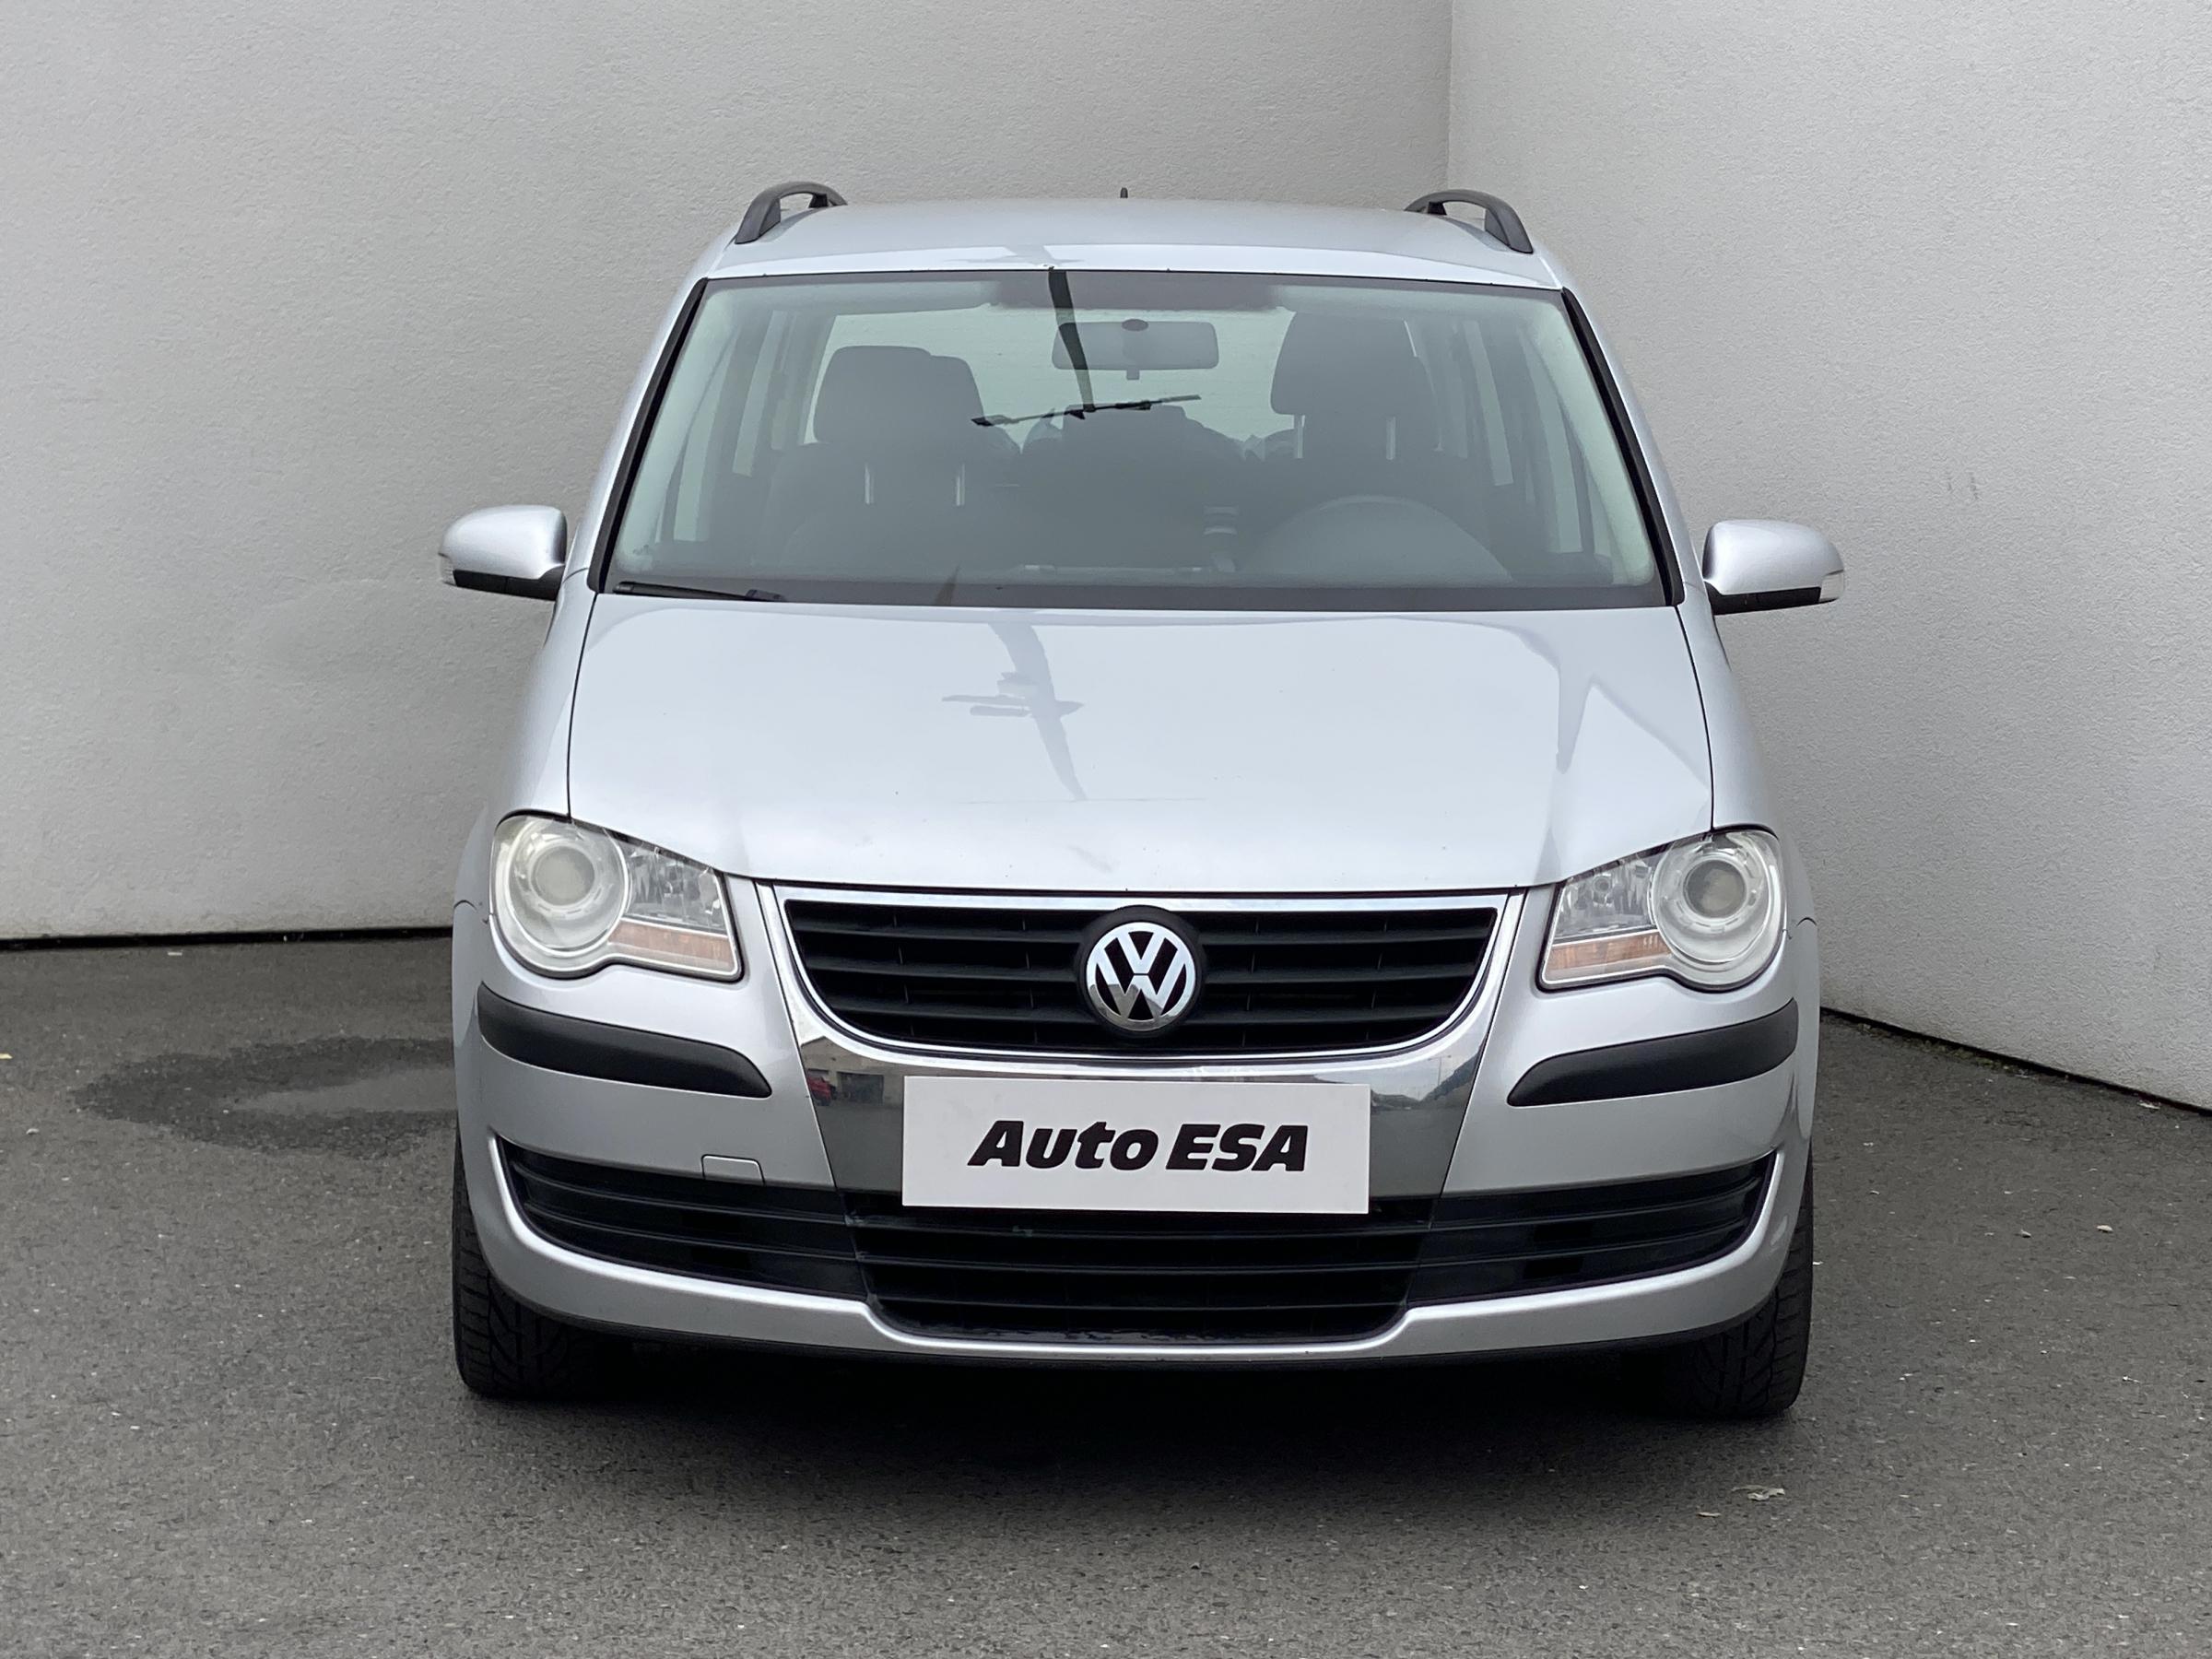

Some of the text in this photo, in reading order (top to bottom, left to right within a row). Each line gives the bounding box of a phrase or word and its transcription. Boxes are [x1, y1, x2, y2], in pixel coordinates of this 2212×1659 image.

[1088, 923, 1194, 1030] VW
[967, 1120, 1309, 1172] Auto ESA
